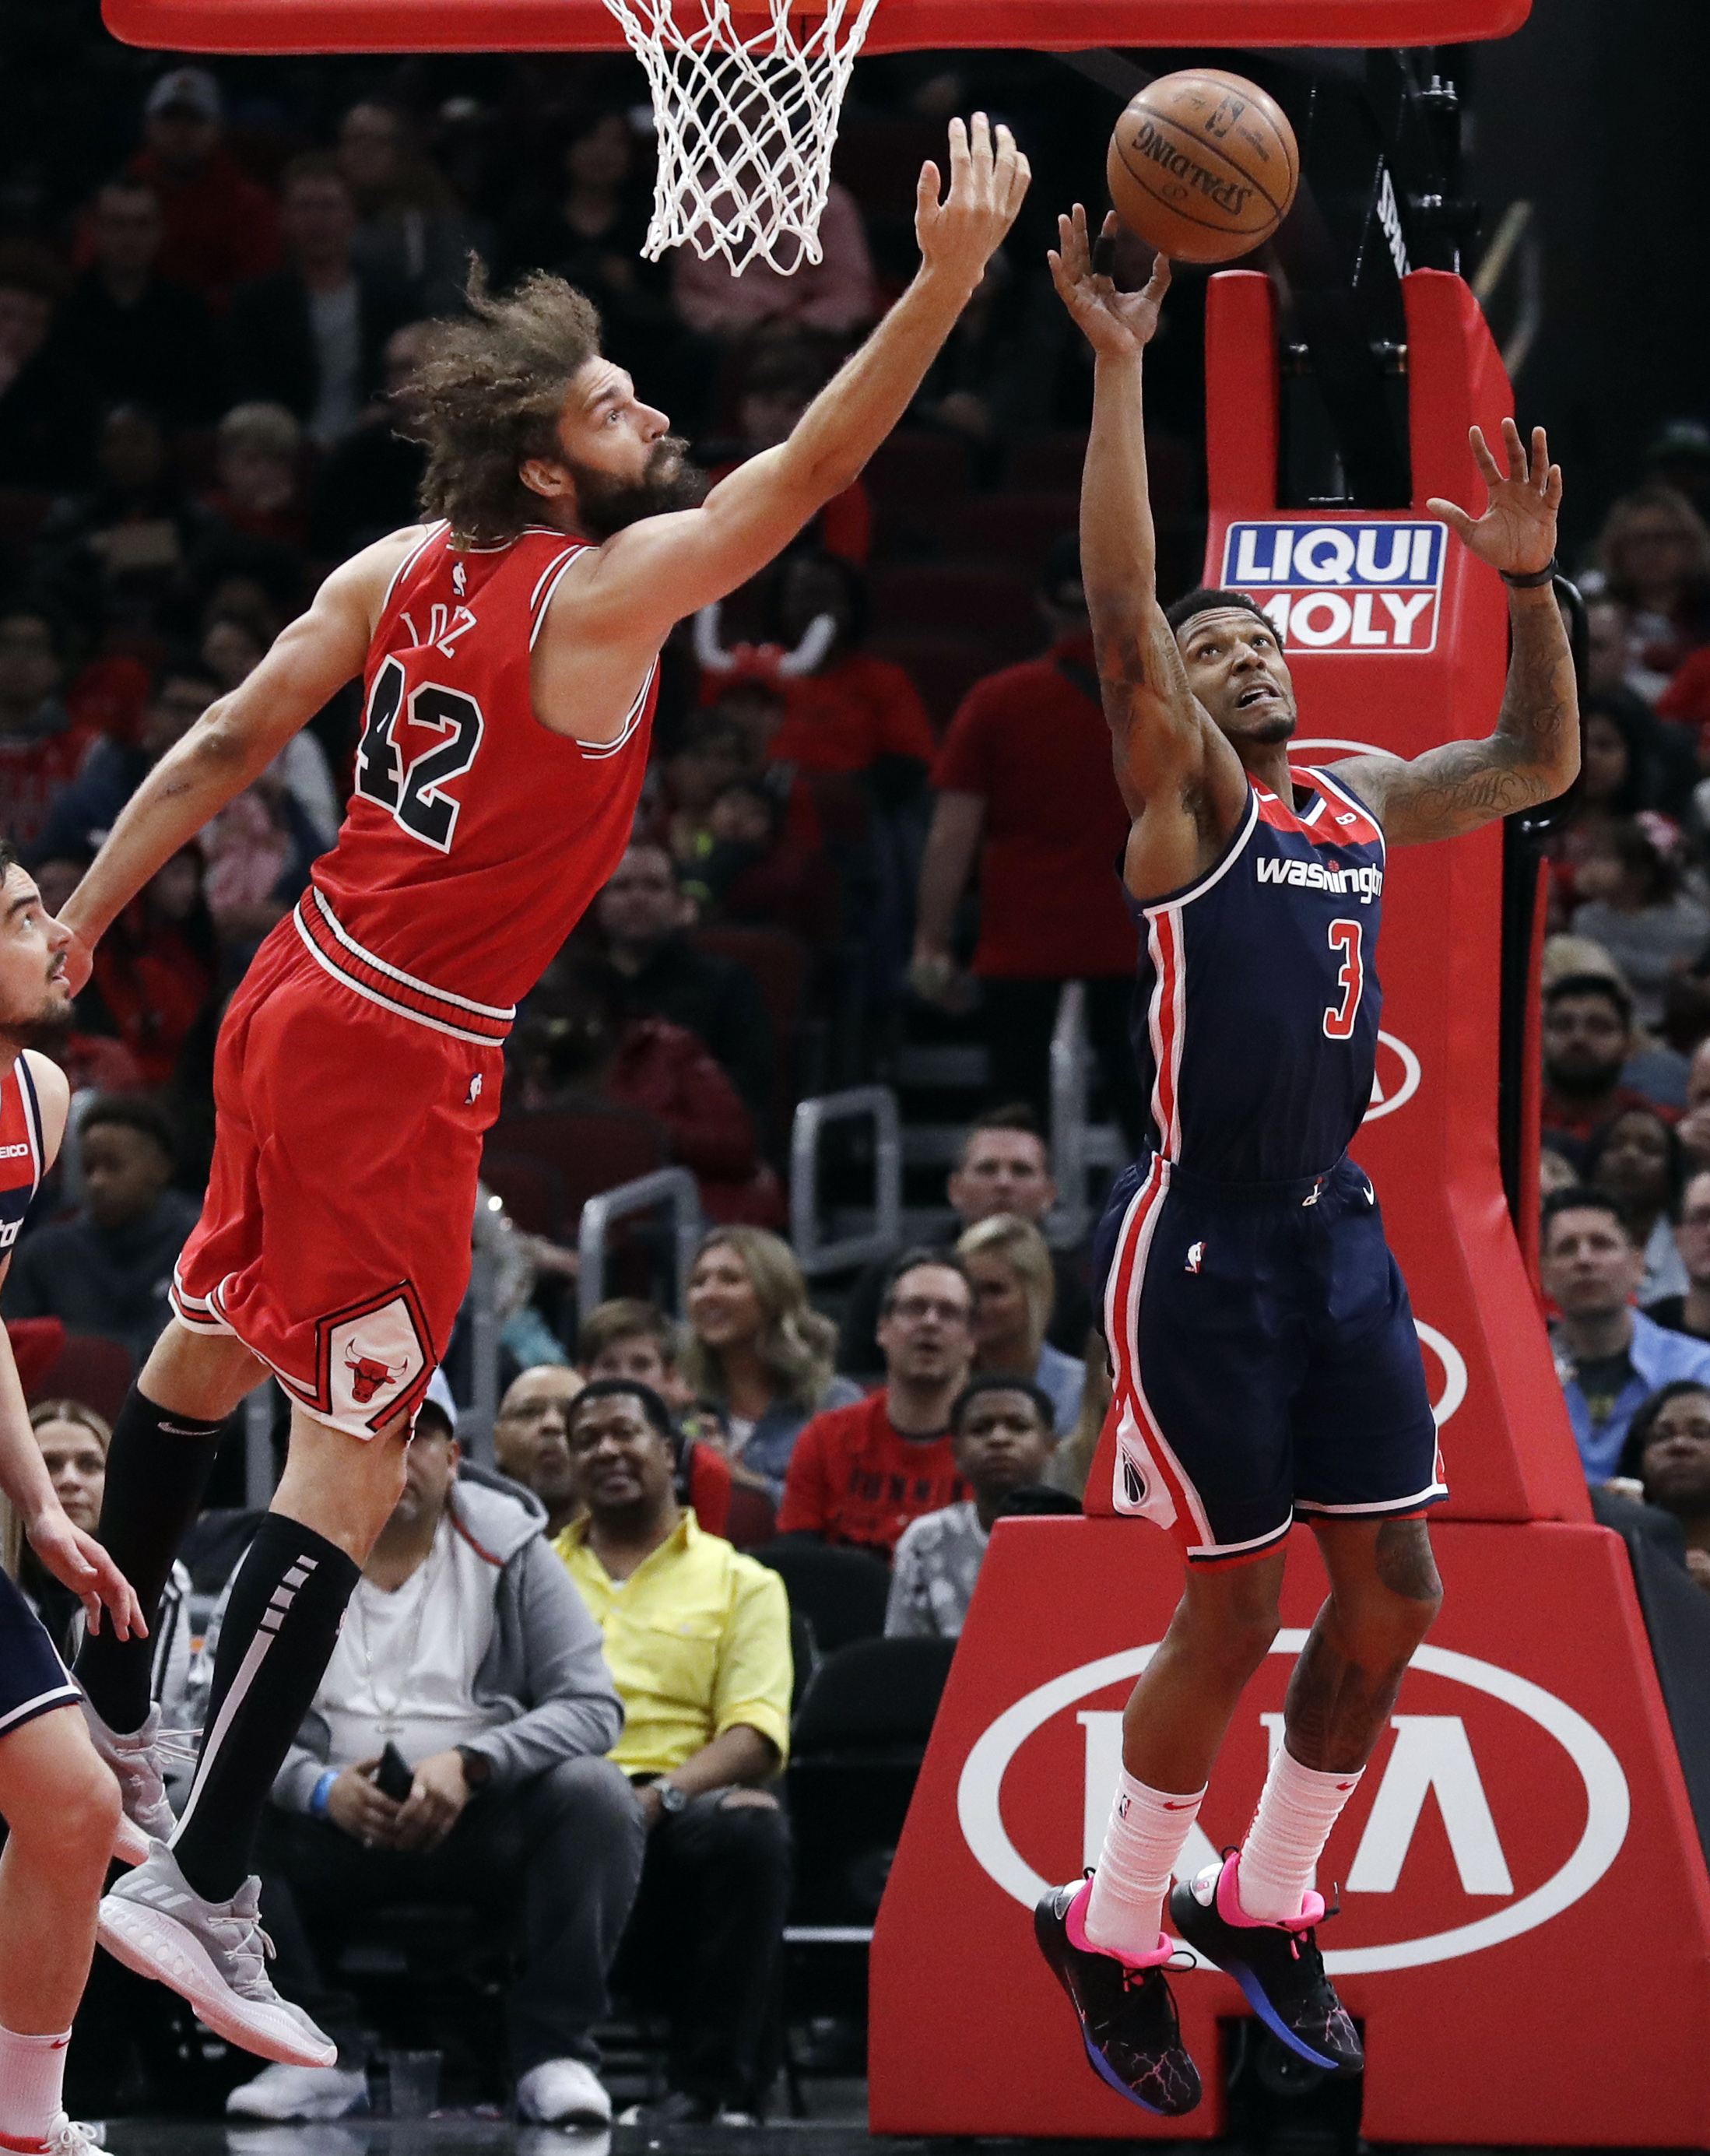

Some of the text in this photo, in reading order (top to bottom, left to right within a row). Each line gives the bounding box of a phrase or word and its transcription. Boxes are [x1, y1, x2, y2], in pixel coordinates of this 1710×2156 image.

[1132, 121, 1252, 216] SPALDING
[1235, 528, 1433, 585] LIQUI
[354, 654, 484, 855] 42
[1323, 918, 1364, 1040] 3
[0, 1143, 29, 1159] EICO
